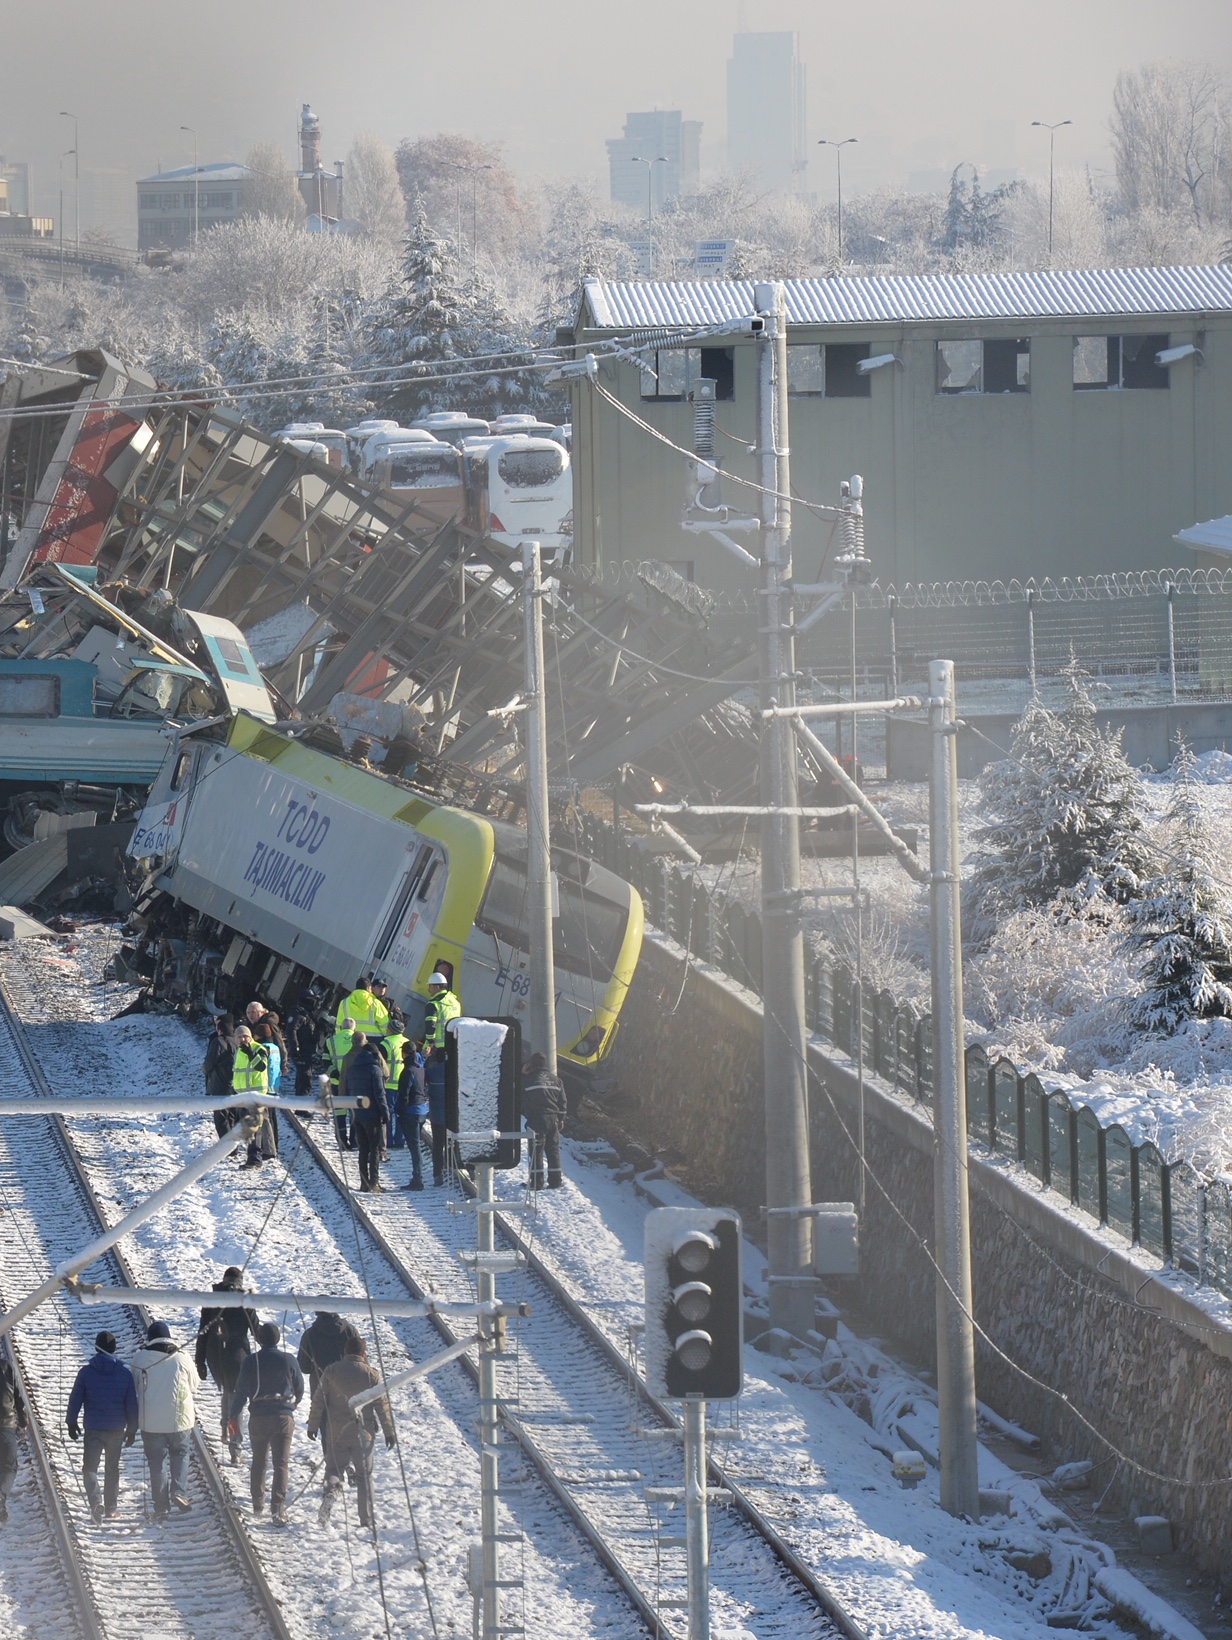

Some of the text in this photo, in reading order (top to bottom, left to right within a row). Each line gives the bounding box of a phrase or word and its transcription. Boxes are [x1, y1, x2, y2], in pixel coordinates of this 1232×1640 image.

[277, 800, 331, 855] TCDD
[244, 841, 327, 912] TAŞIMACILIK
[494, 966, 531, 996] E 68
